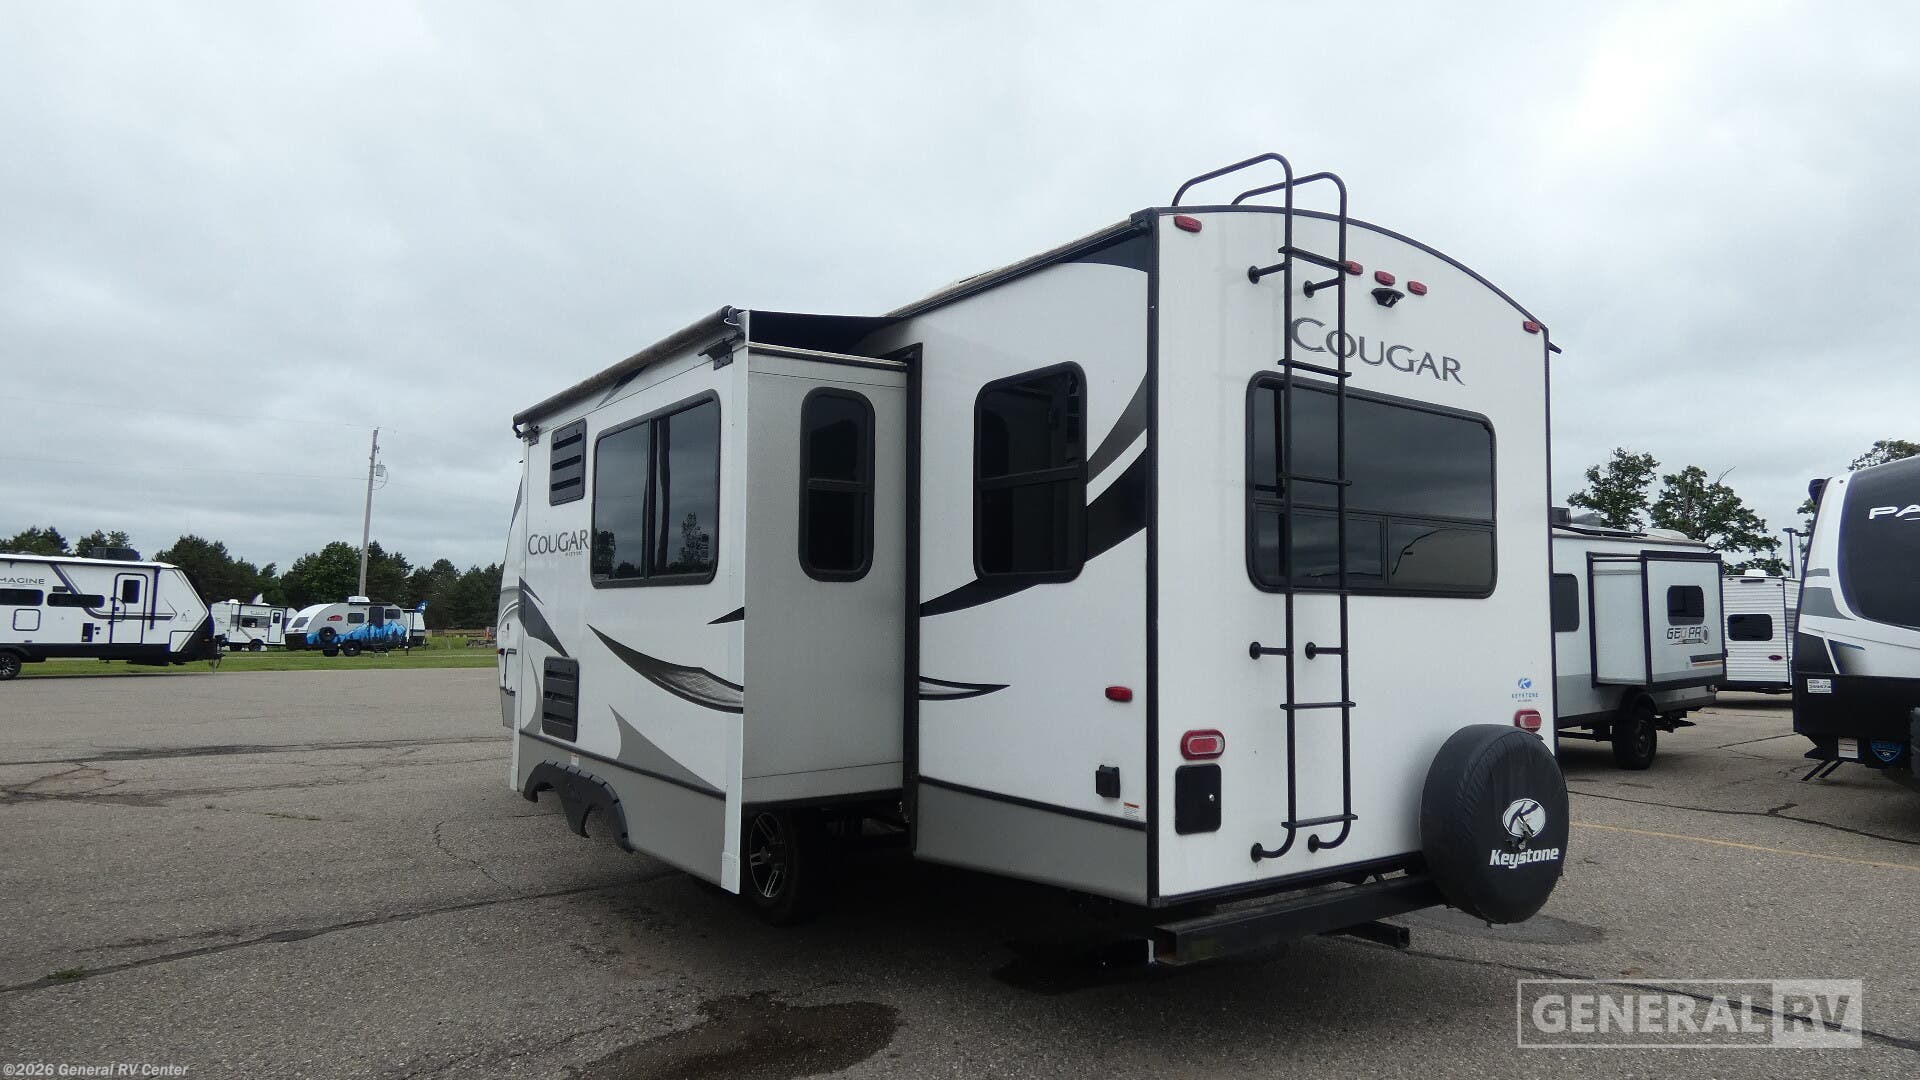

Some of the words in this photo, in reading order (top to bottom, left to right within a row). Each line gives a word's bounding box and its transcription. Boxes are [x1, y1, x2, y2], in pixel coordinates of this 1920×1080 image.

[1291, 317, 1466, 386] COUGAR
[527, 529, 590, 556] COUGAR
[1489, 847, 1560, 870] Keystone
